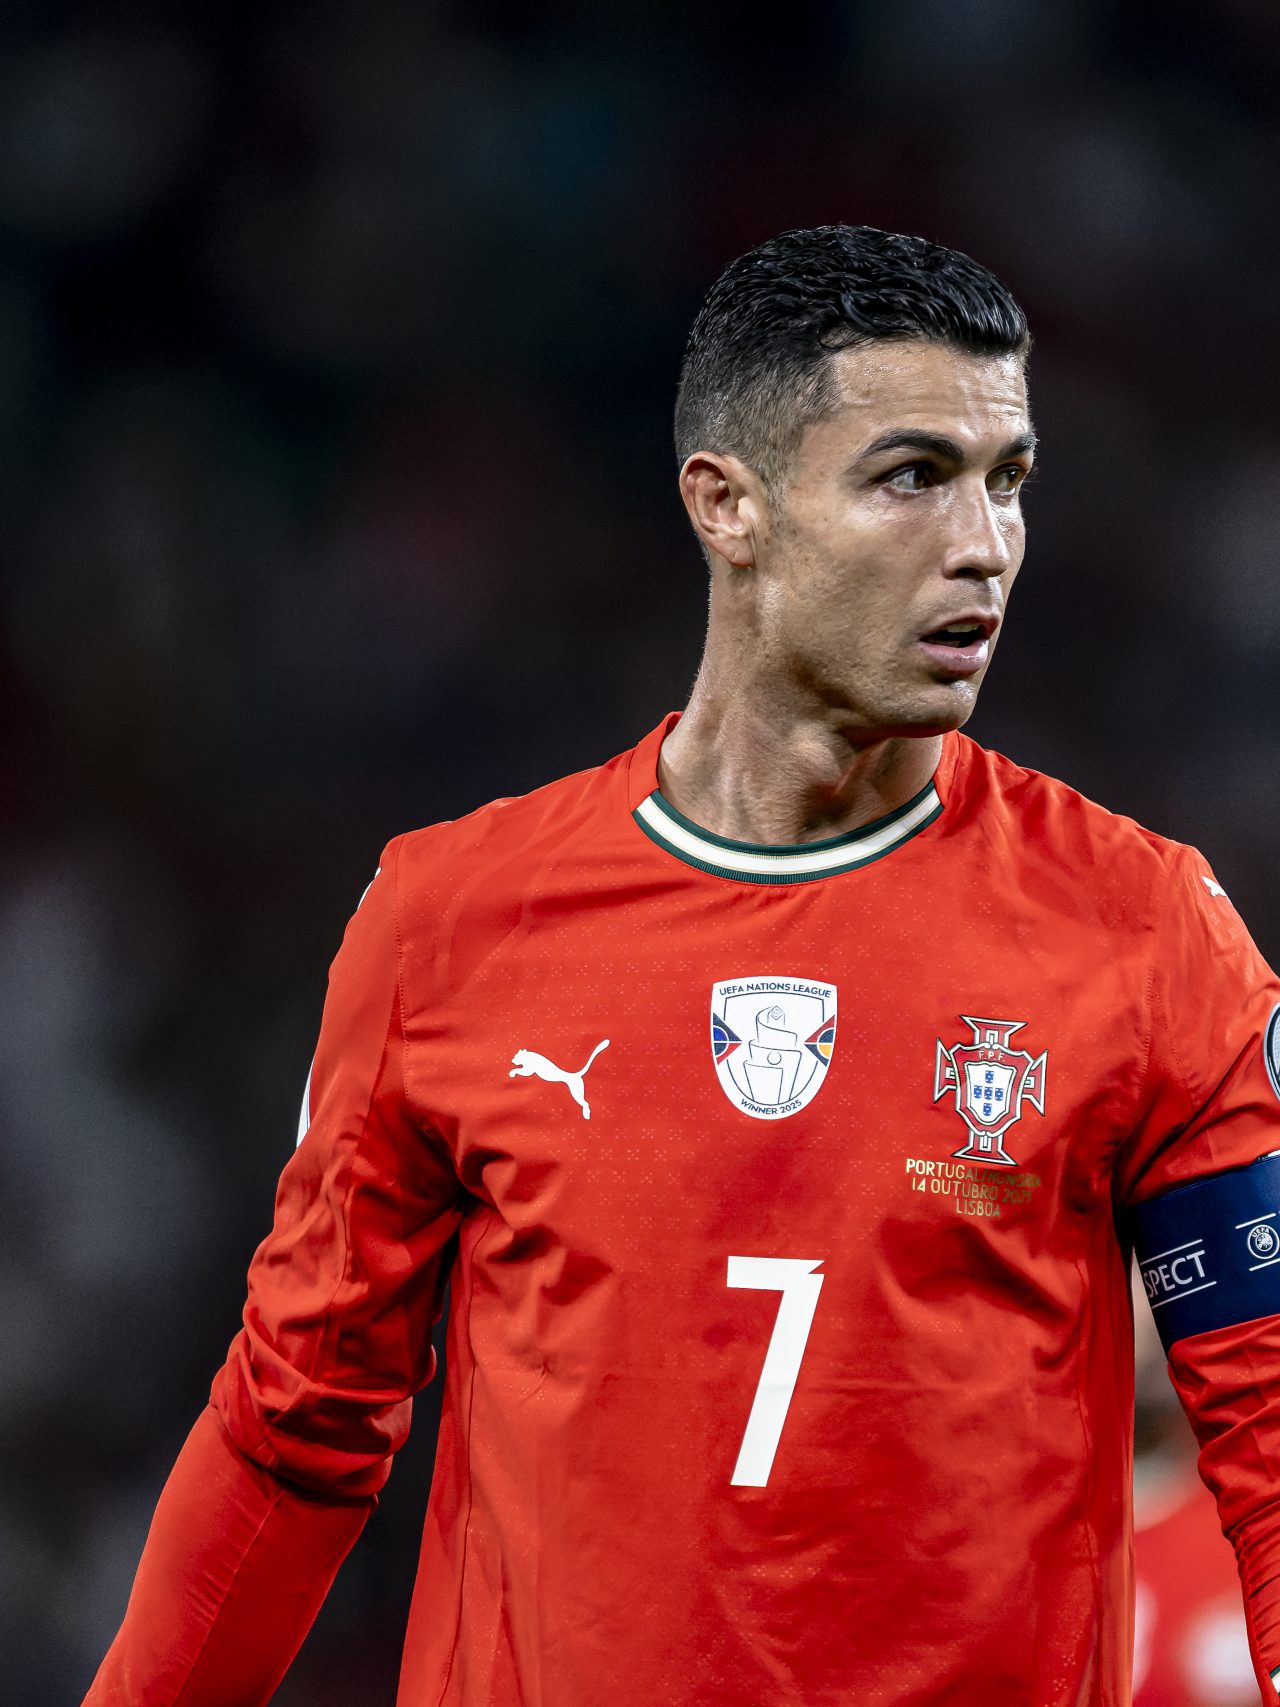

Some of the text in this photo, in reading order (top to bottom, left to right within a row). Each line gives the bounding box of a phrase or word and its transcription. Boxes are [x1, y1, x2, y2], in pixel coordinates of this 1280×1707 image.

[719, 982, 832, 998] UEFA NATIONS LEAGUE
[740, 1098, 802, 1115] WINNER 2025
[912, 1177, 926, 1192] 14
[930, 1178, 999, 1201] OUTUBRO
[956, 1198, 1001, 1217] LISBOA
[1251, 1226, 1271, 1239] UEFA
[726, 1256, 825, 1488] 7
